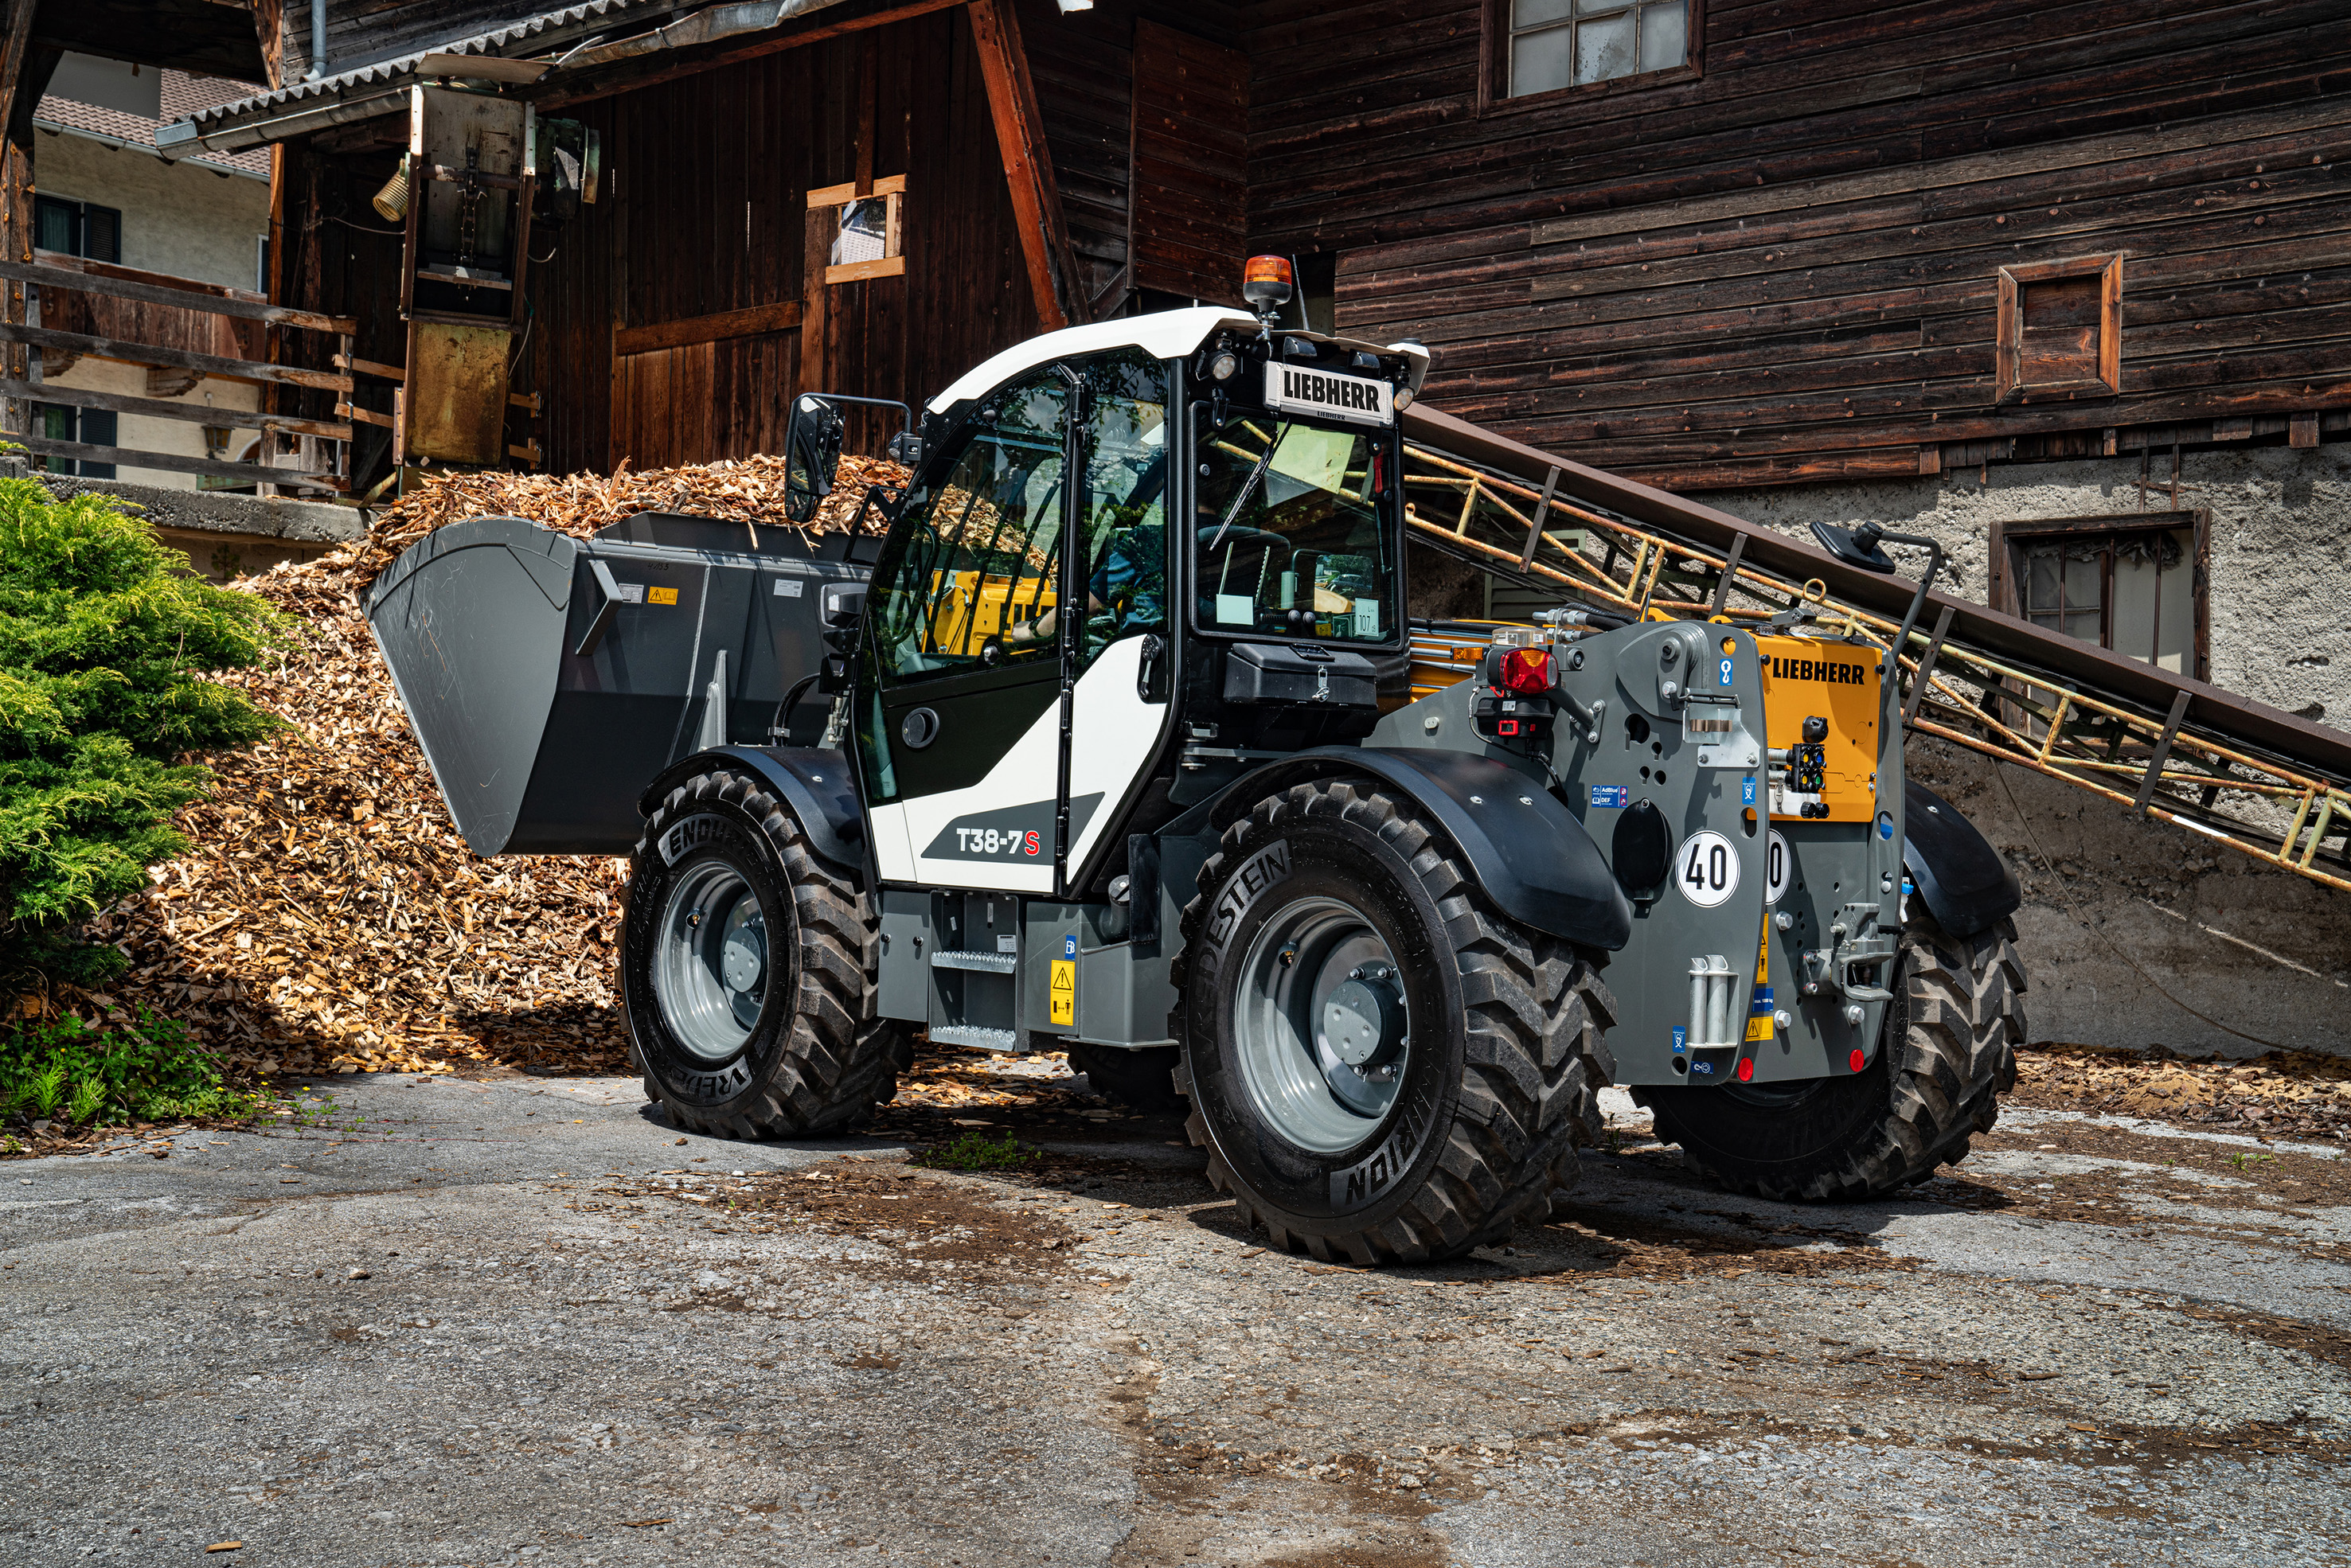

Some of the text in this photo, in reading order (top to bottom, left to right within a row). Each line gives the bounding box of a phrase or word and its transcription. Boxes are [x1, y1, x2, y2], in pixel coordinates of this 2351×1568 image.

[1284, 371, 1380, 412] LIEBHERR
[1317, 411, 1345, 421] LIEBHERR
[1359, 614, 1370, 631] 107
[1773, 657, 1865, 685] LIEBHERR
[956, 828, 1040, 856] T38-7S
[1685, 844, 1726, 891] 40
[1770, 842, 1782, 887] 0
